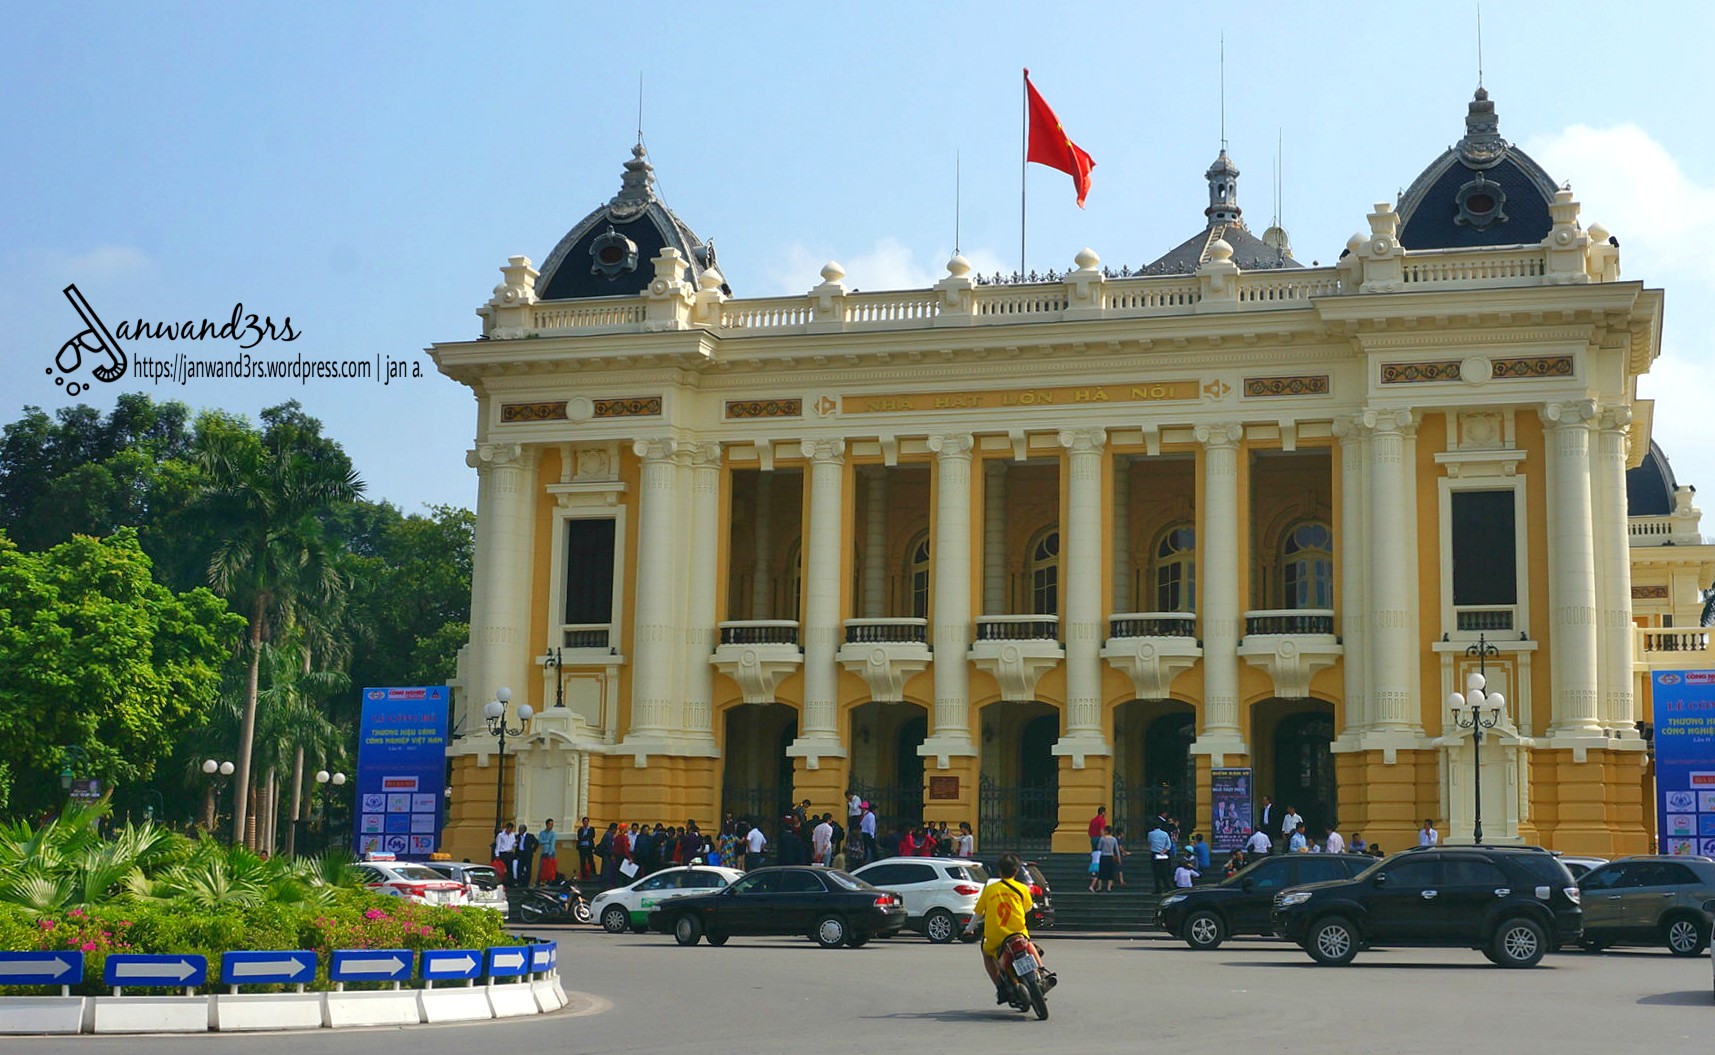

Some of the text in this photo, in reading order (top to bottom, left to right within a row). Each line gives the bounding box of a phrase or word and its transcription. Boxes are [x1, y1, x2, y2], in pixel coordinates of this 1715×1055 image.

[1075, 386, 1109, 401] HÀ
[1131, 383, 1175, 401] NỘI
[1661, 727, 1685, 735] CÔNG
[365, 737, 383, 745] CÔNG
[411, 737, 426, 747] VIỆT
[997, 902, 1011, 927] 9
